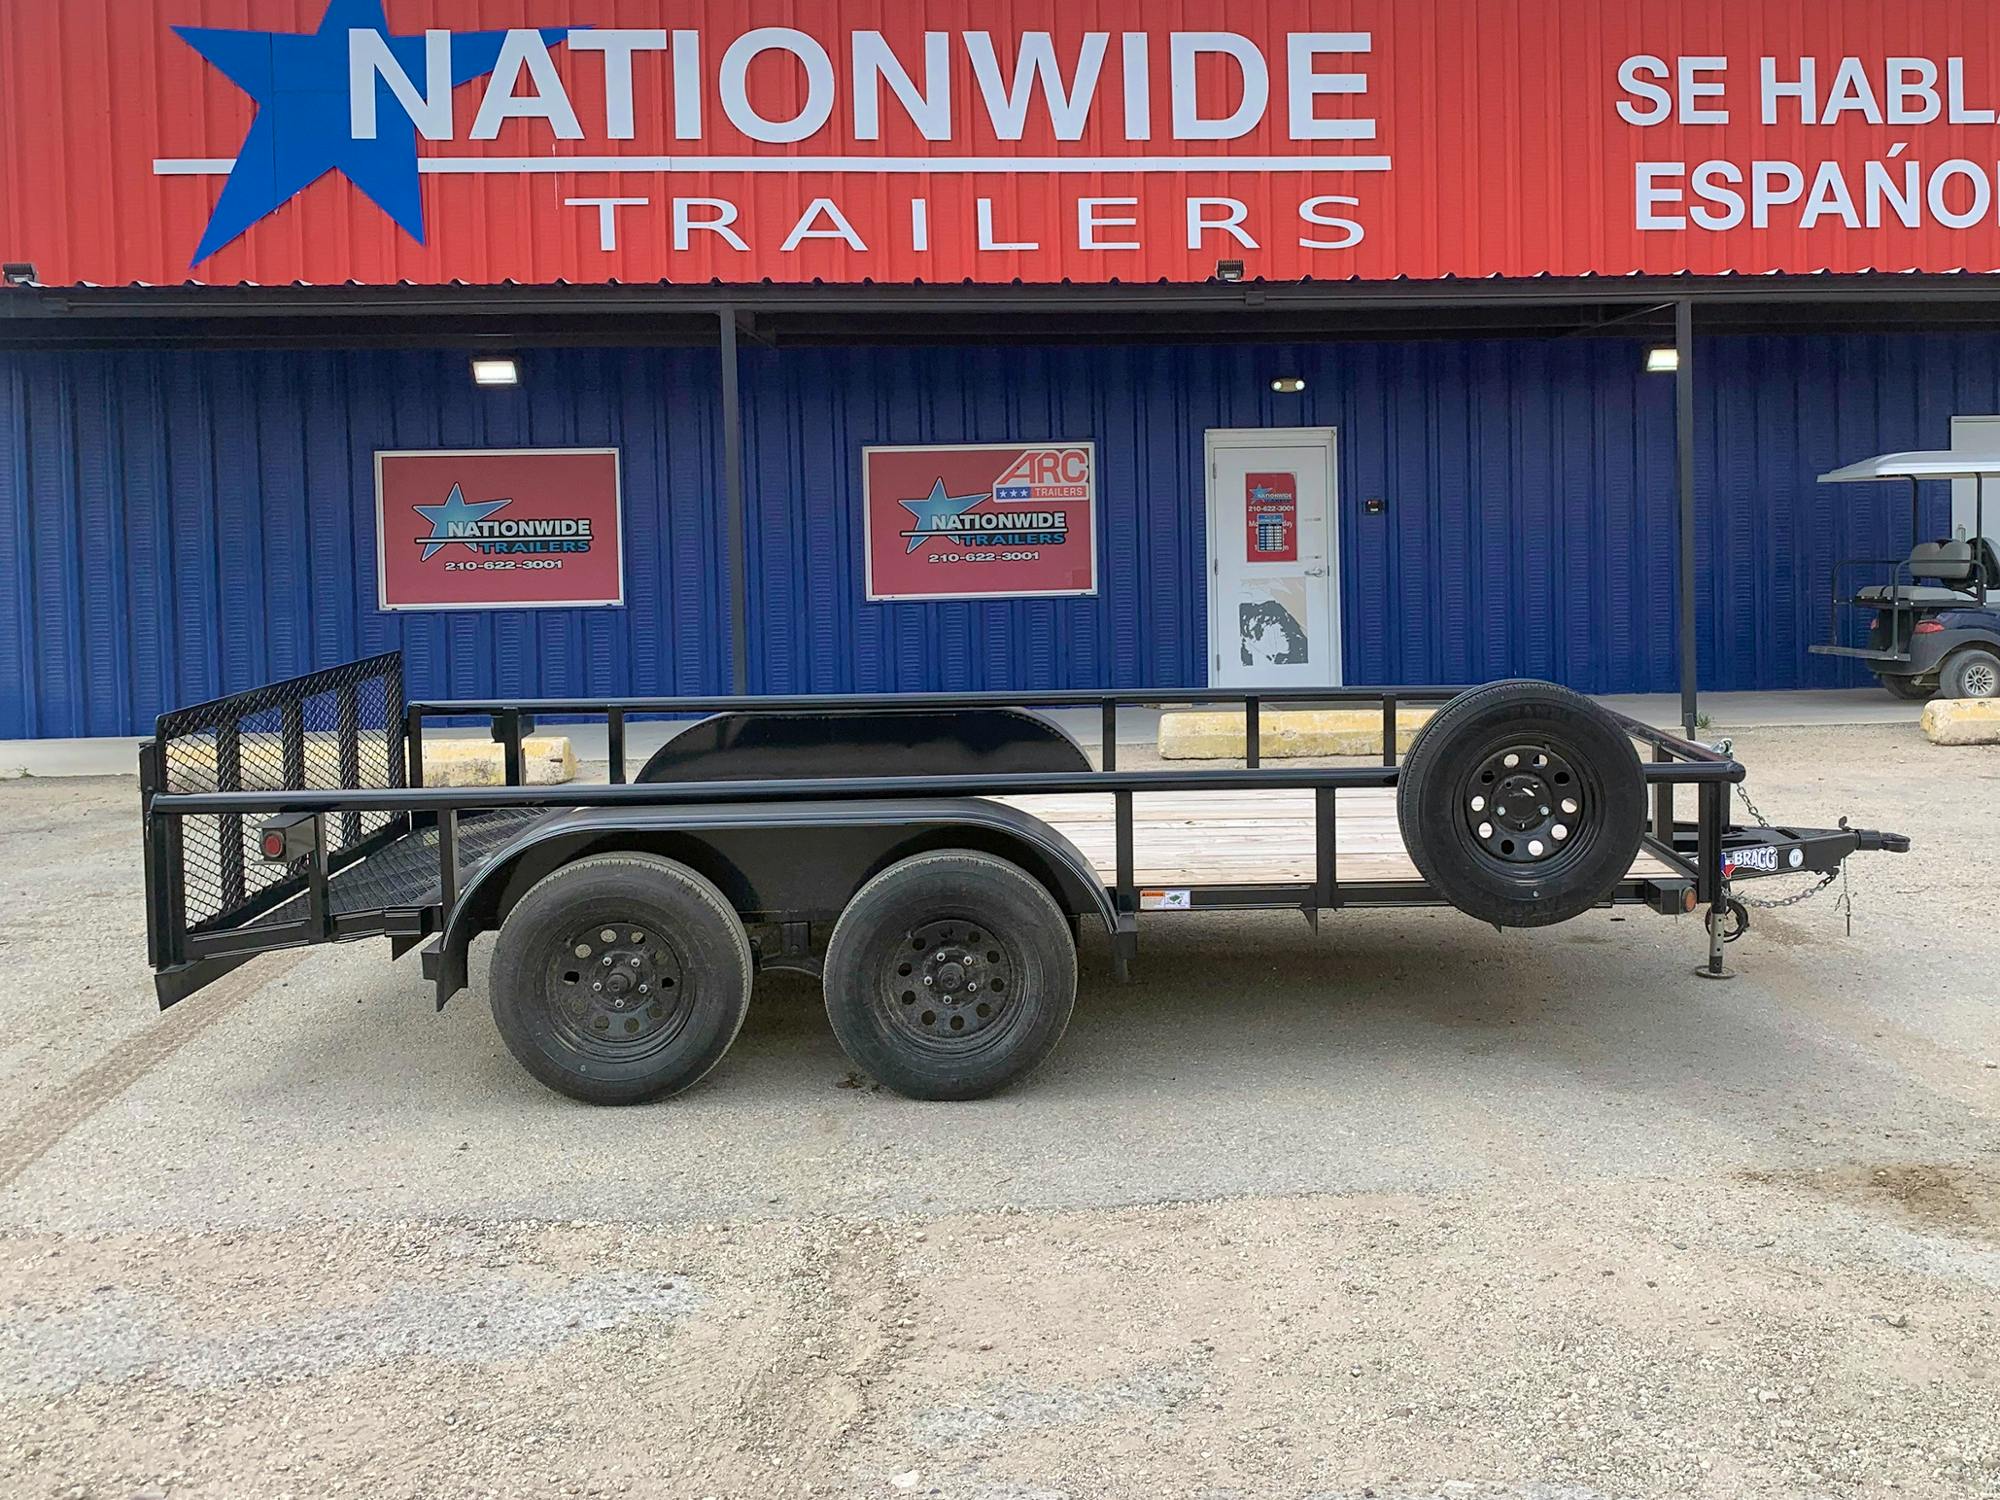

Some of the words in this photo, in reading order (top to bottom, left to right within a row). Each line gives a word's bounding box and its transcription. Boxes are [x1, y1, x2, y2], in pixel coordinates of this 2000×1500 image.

[348, 27, 1377, 141] NATIONWIDE
[1615, 55, 1729, 126] SE
[1760, 56, 2000, 125] HABL
[1635, 142, 2000, 231] ESPAŃO
[563, 194, 1366, 250] TRAILERS
[999, 450, 1087, 484] ARC
[1035, 487, 1083, 497] TRAILERS
[448, 519, 591, 537] NATIONWIDE
[931, 512, 1066, 530] NATIONWIDE
[478, 541, 590, 553] TRAILERS
[962, 533, 1065, 545] TRAILERS
[445, 560, 563, 571] 210-622-3001
[928, 551, 1040, 563] 210-622-3001
[1733, 847, 1777, 870] BRAGG
